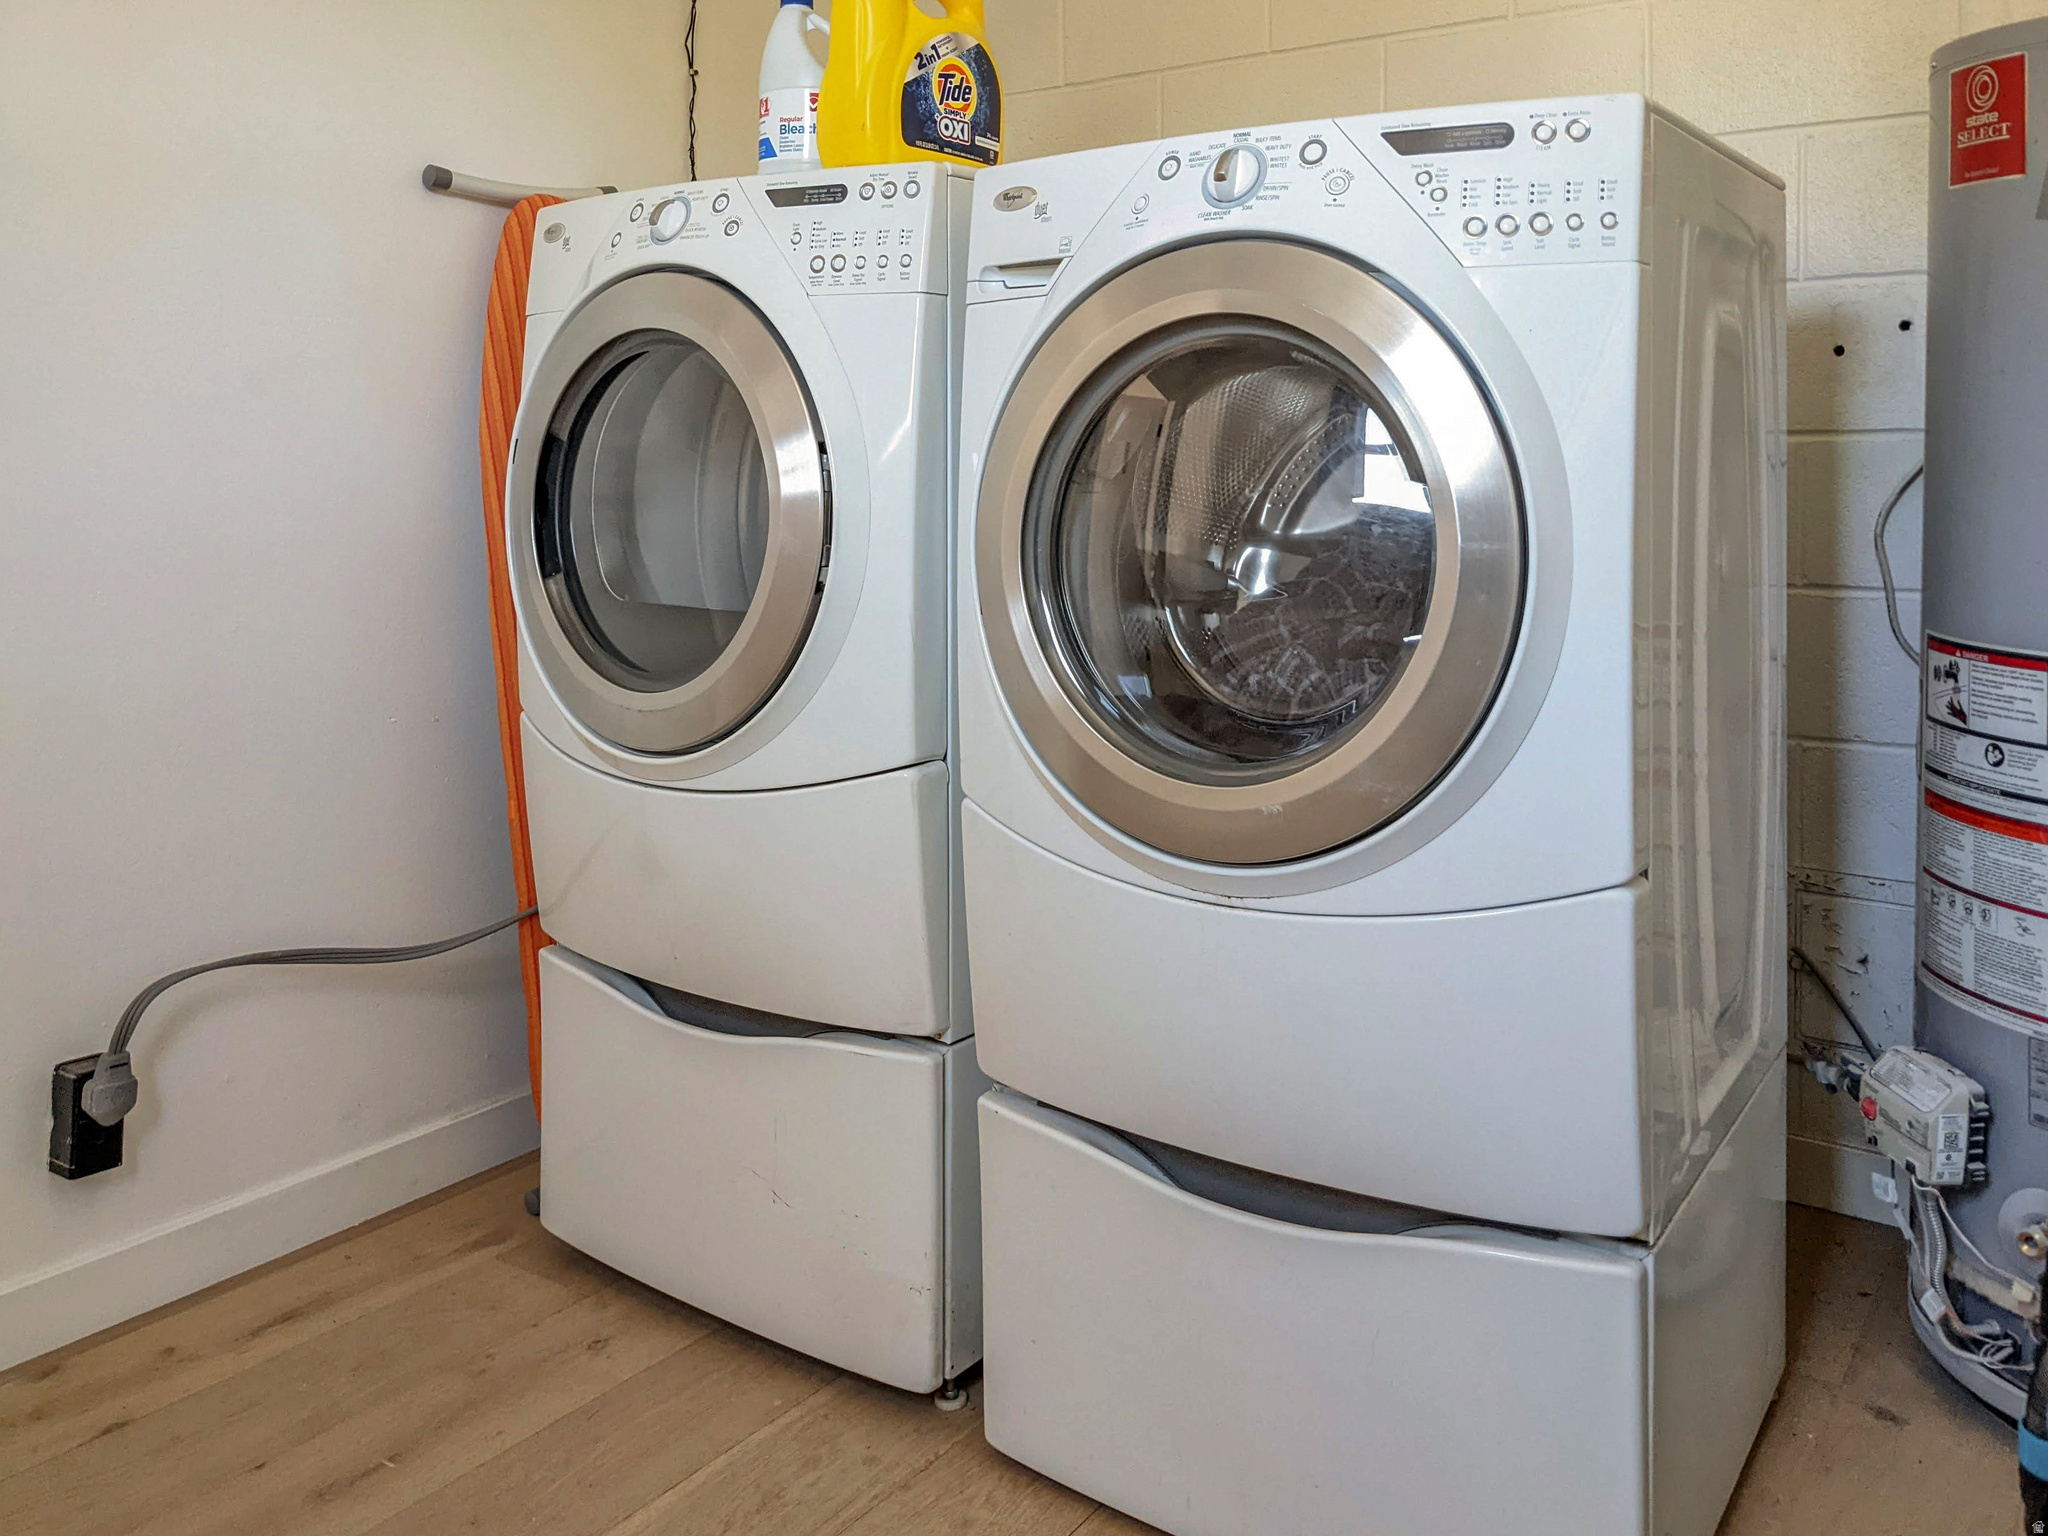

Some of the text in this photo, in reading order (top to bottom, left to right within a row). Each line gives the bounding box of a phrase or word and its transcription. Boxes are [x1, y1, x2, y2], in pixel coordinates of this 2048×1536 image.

[914, 43, 941, 71] 2in1
[938, 73, 973, 105] Tide
[943, 108, 967, 119] SIMPLY
[939, 116, 969, 142] OXI
[1957, 121, 2012, 145] SELECT
[1208, 142, 1227, 150] DELICATE
[1188, 154, 1212, 163] WASHABLES
[1321, 168, 1335, 181] PAUSE
[1339, 167, 1355, 181] CANCEL
[1003, 192, 1023, 202] Whirlpool
[1197, 211, 1212, 219] CLEAN
[1212, 209, 1231, 217] WASHER
[1962, 650, 1989, 663] DANGER
